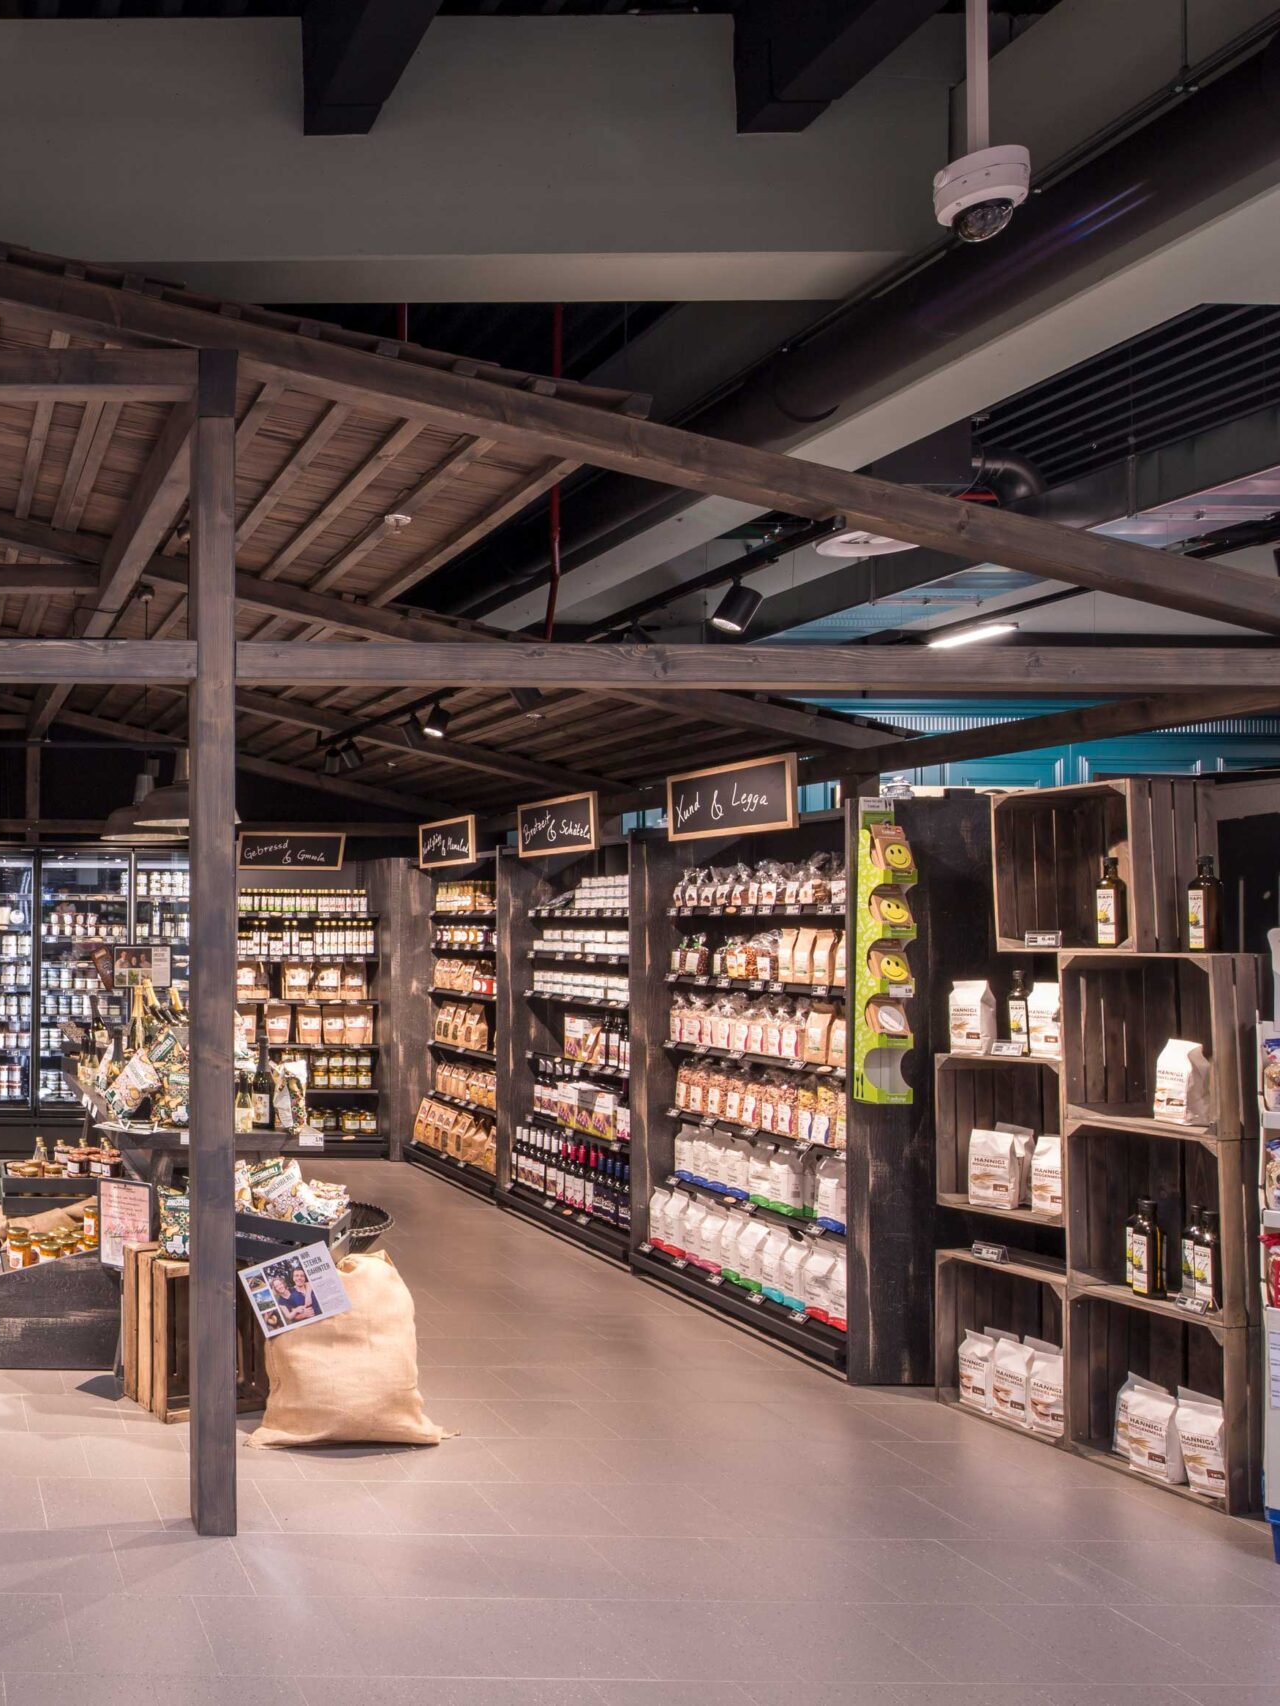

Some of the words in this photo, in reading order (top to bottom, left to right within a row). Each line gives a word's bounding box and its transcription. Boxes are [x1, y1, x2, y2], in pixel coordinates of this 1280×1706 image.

[676, 791, 700, 828] Xund
[711, 789, 724, 820] &
[731, 782, 769, 812] Legga
[303, 1256, 322, 1268] STEHEN
[306, 1263, 331, 1276] DAHINTER
[1129, 1416, 1163, 1432] HANNIGS
[1180, 1433, 1215, 1447] HANNIGS
